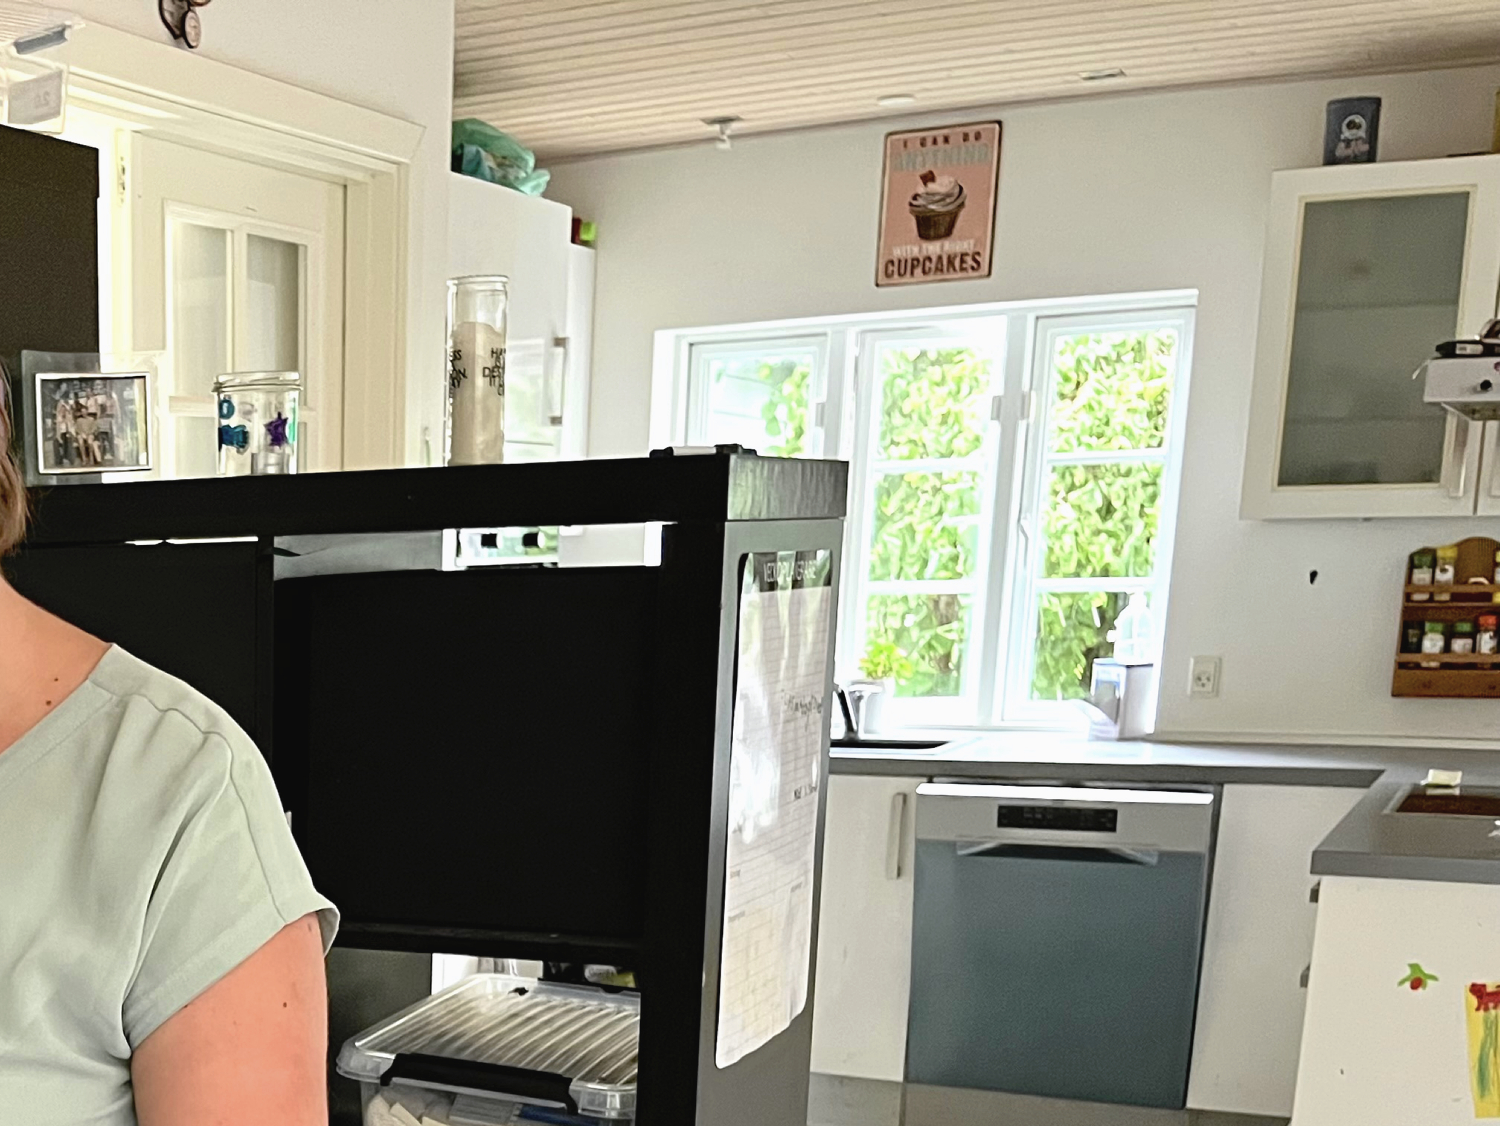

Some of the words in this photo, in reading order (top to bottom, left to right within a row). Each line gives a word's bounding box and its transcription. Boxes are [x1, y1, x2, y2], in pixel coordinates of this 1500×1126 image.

[919, 134, 950, 148] CAN
[962, 130, 982, 143] DO
[884, 251, 982, 279] CUPCAKES
